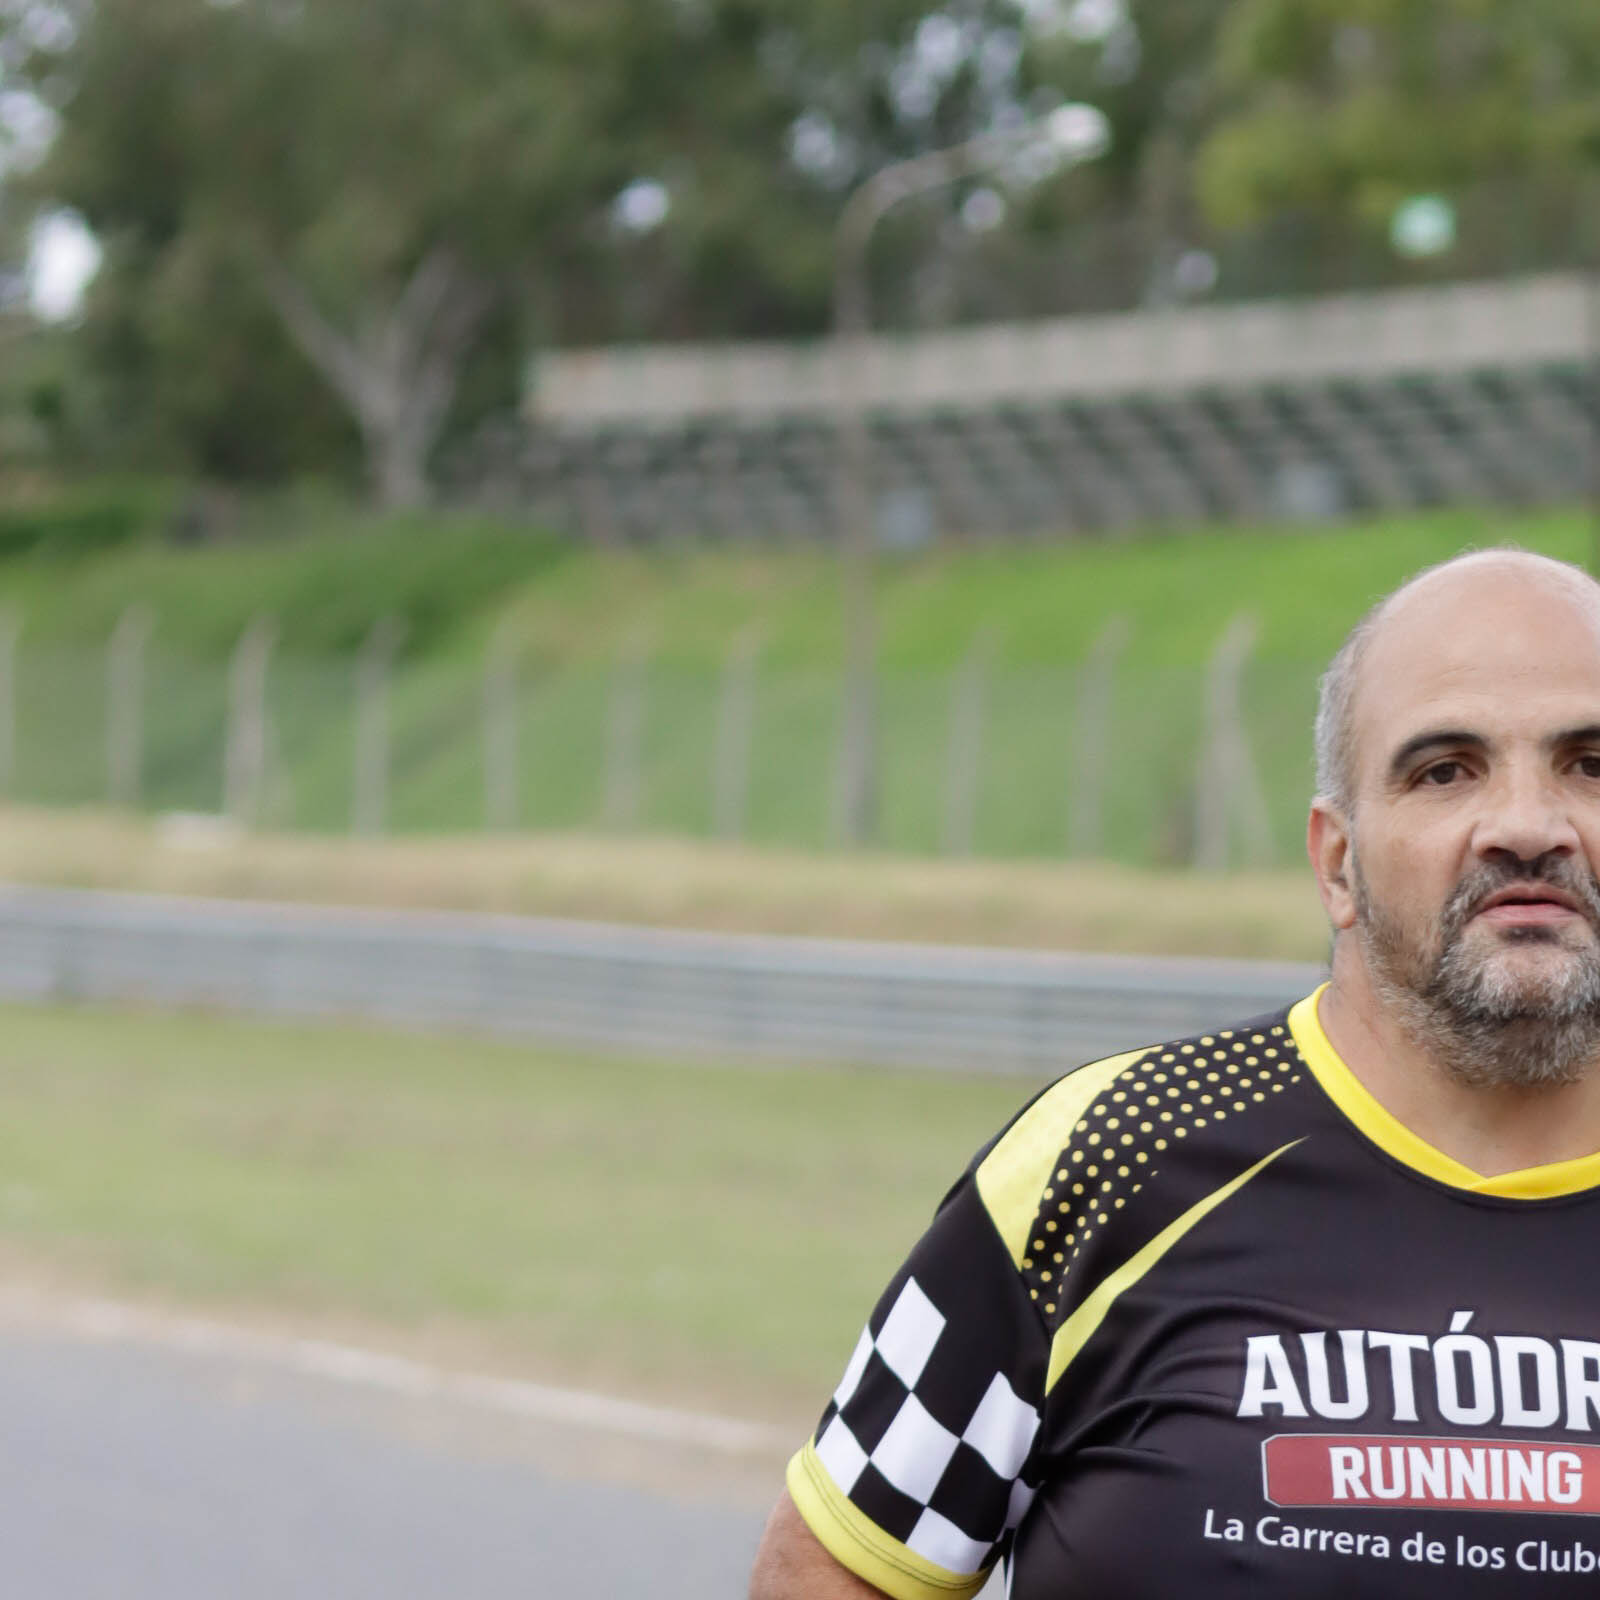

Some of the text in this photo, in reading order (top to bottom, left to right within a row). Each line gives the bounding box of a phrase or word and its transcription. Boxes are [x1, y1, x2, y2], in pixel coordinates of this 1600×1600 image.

[1329, 1445, 1583, 1505] RUNNING
[1204, 1509, 1244, 1541] La
[1256, 1516, 1390, 1558] Carrera
[1401, 1531, 1446, 1564] de
[1456, 1535, 1506, 1569] los
